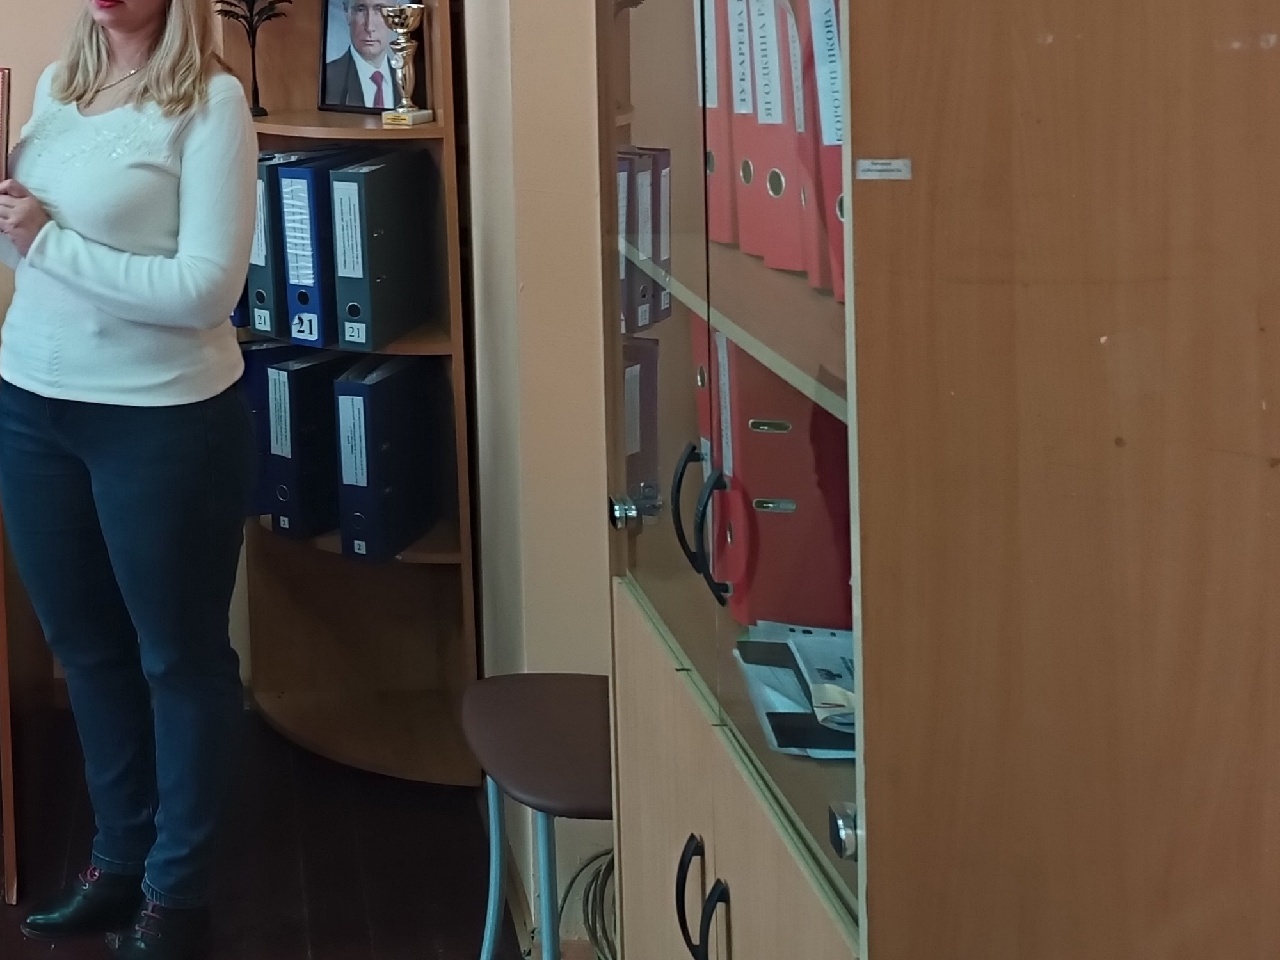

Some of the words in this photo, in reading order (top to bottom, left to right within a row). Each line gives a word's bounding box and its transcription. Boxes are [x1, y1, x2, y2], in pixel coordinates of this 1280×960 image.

[257, 314, 267, 326] 21
[297, 315, 314, 336] 21
[348, 326, 360, 339] 21
